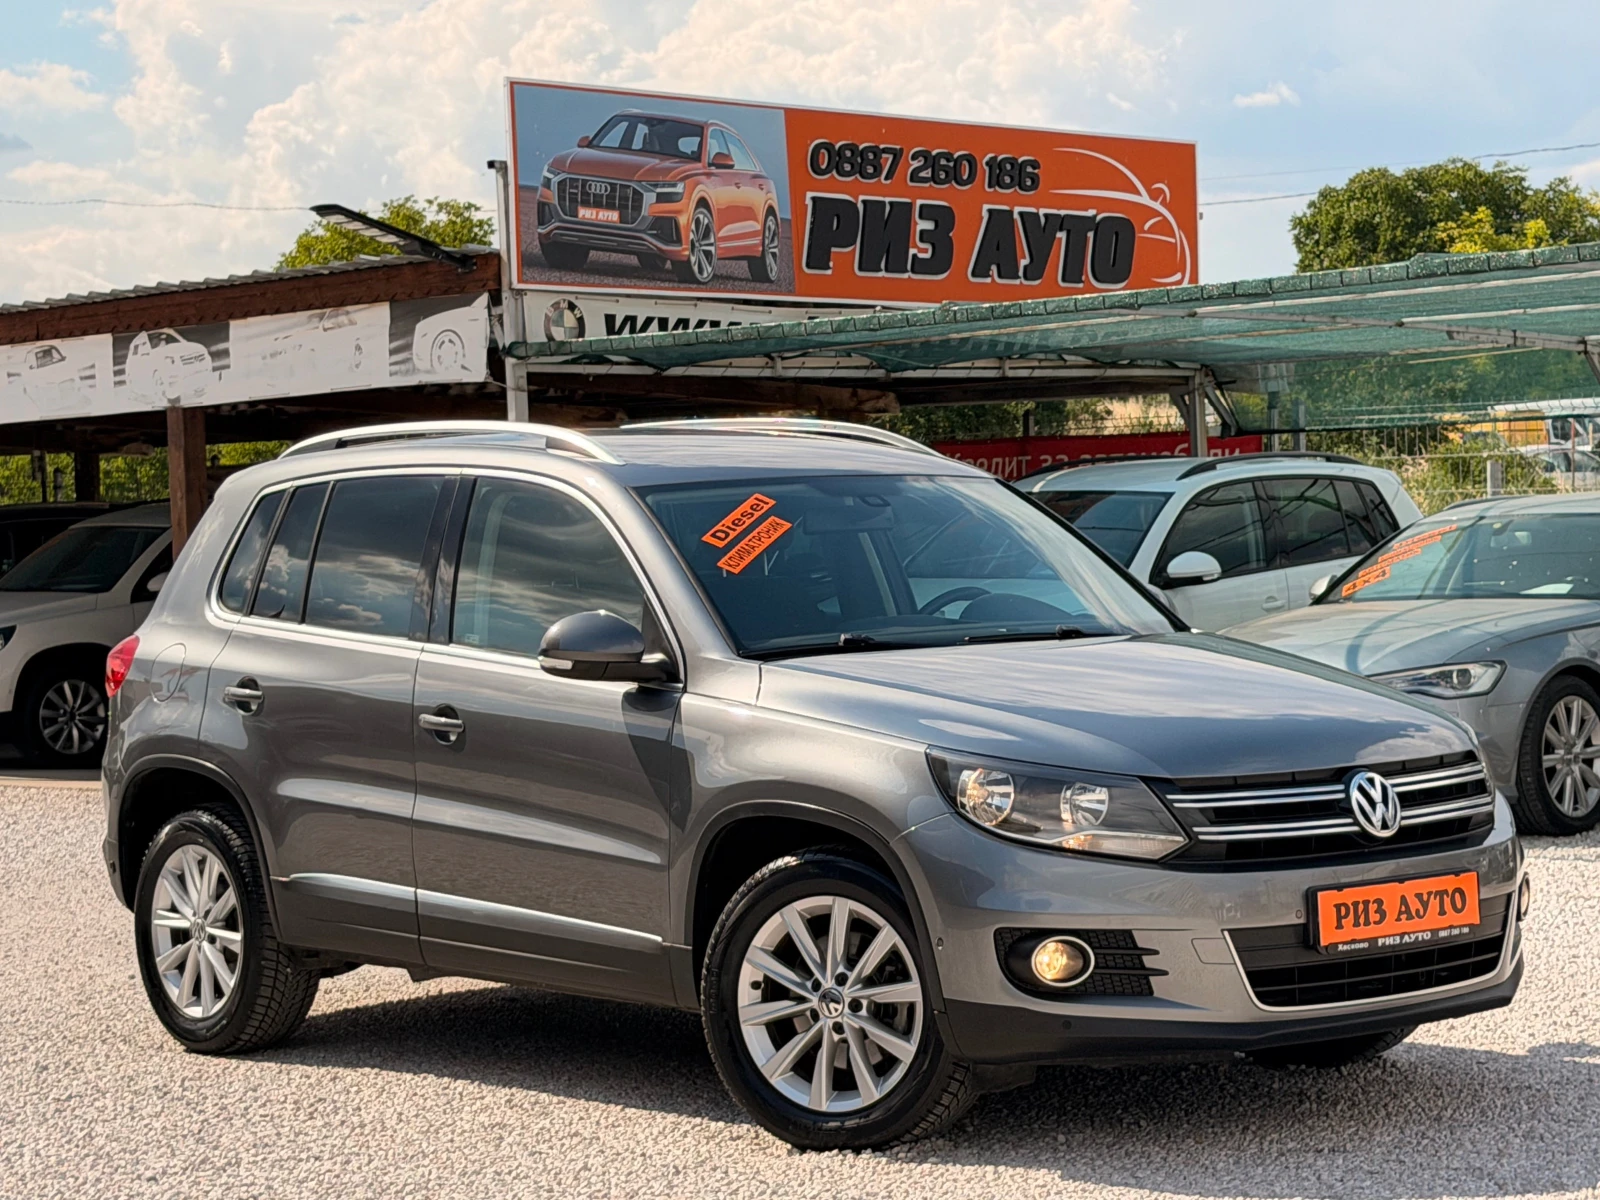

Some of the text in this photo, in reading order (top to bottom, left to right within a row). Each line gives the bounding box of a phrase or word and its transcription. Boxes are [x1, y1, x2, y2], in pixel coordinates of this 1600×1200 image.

[809, 139, 1041, 194] 0887 260 186
[803, 192, 1136, 288] РИЗ АУТО
[709, 497, 770, 542] Diesel
[722, 518, 786, 570] КЛИМАТРОНИК
[1333, 887, 1467, 930] РИЗ АУТО
[1377, 935, 1400, 947] РИЗ
[1402, 931, 1432, 943] АУТО
